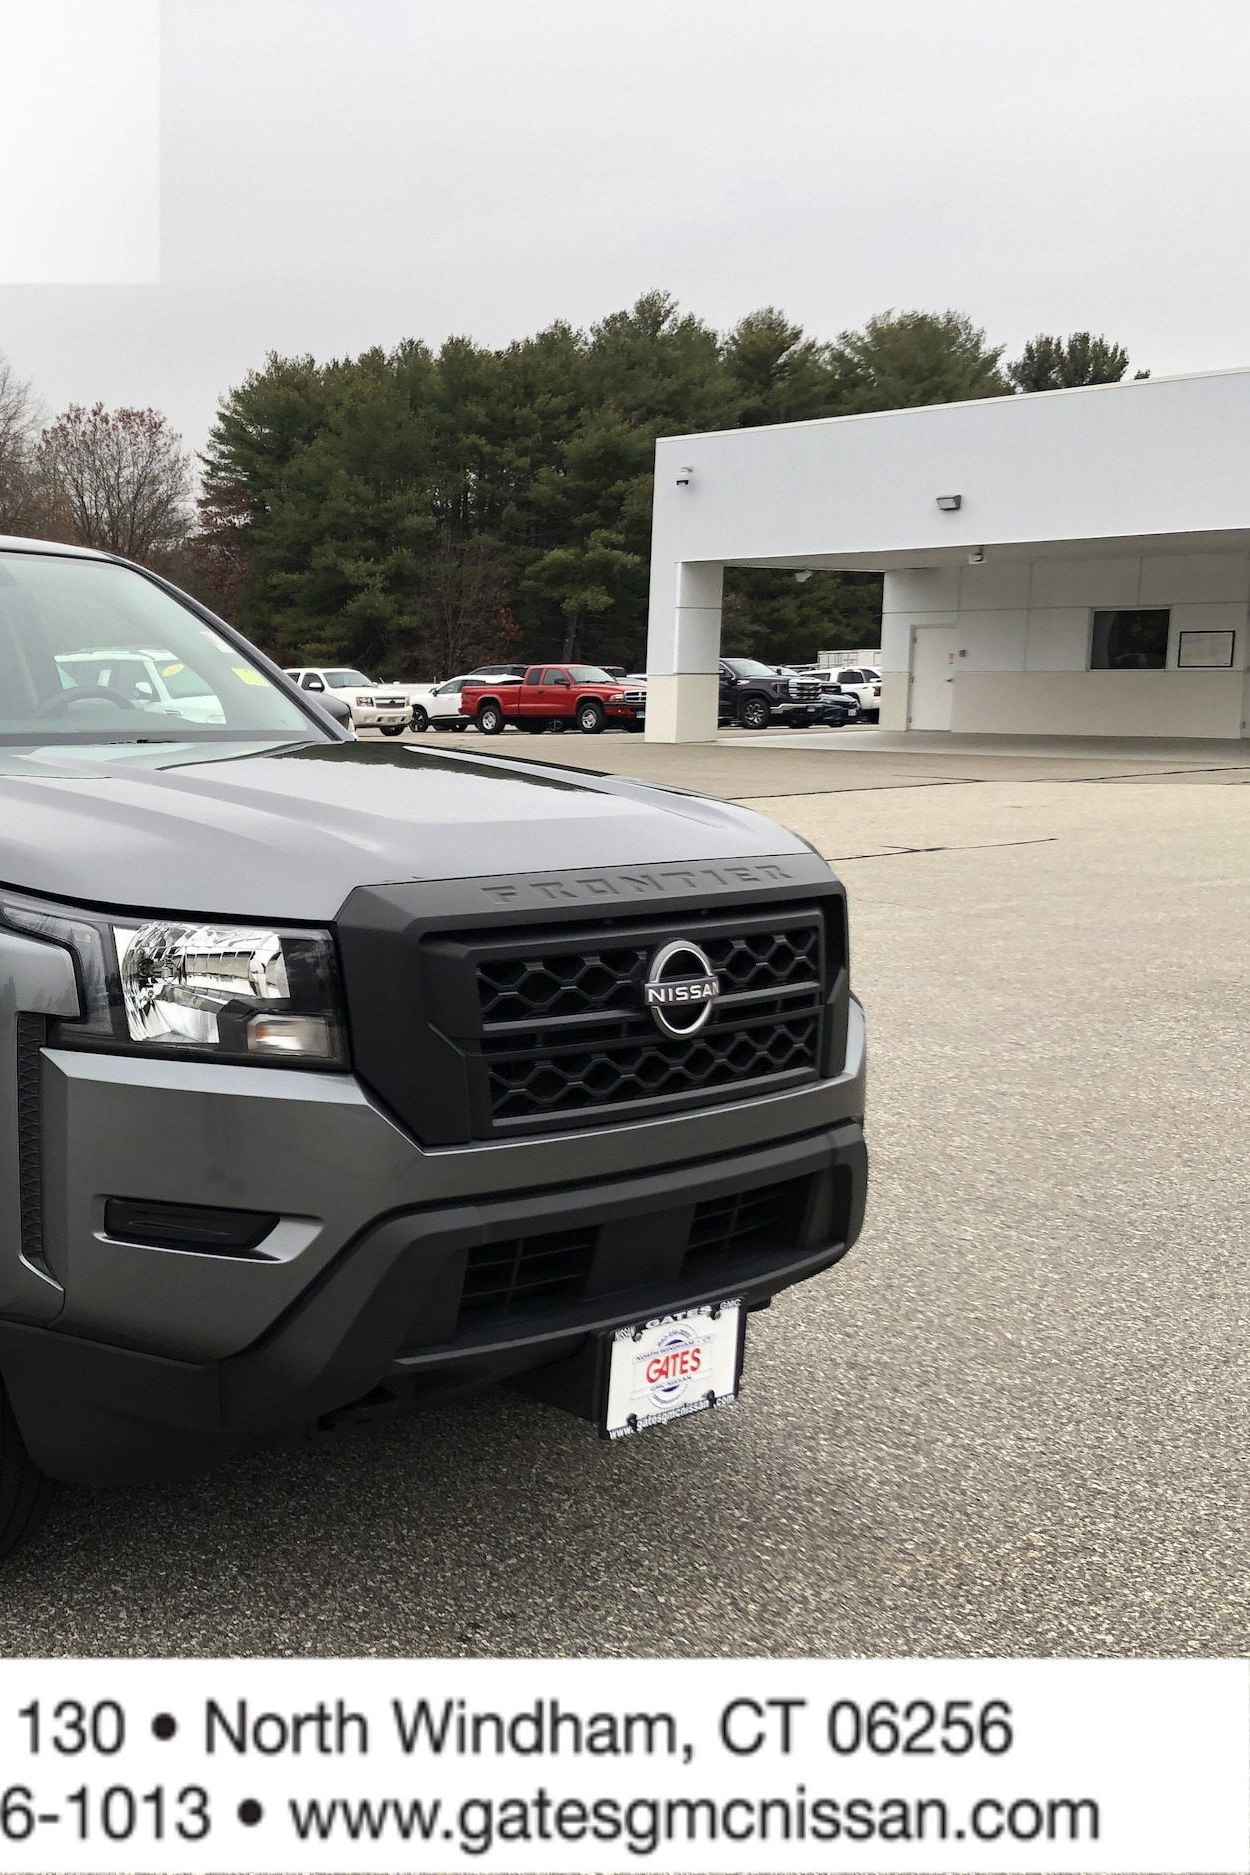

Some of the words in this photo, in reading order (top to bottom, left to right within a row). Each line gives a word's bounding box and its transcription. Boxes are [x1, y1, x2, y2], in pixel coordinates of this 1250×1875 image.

[481, 864, 793, 905] FRONTIER
[648, 981, 719, 1003] NISSAN
[645, 1305, 713, 1330] GATES
[719, 1298, 742, 1311] GMC
[645, 1347, 702, 1384] GATES
